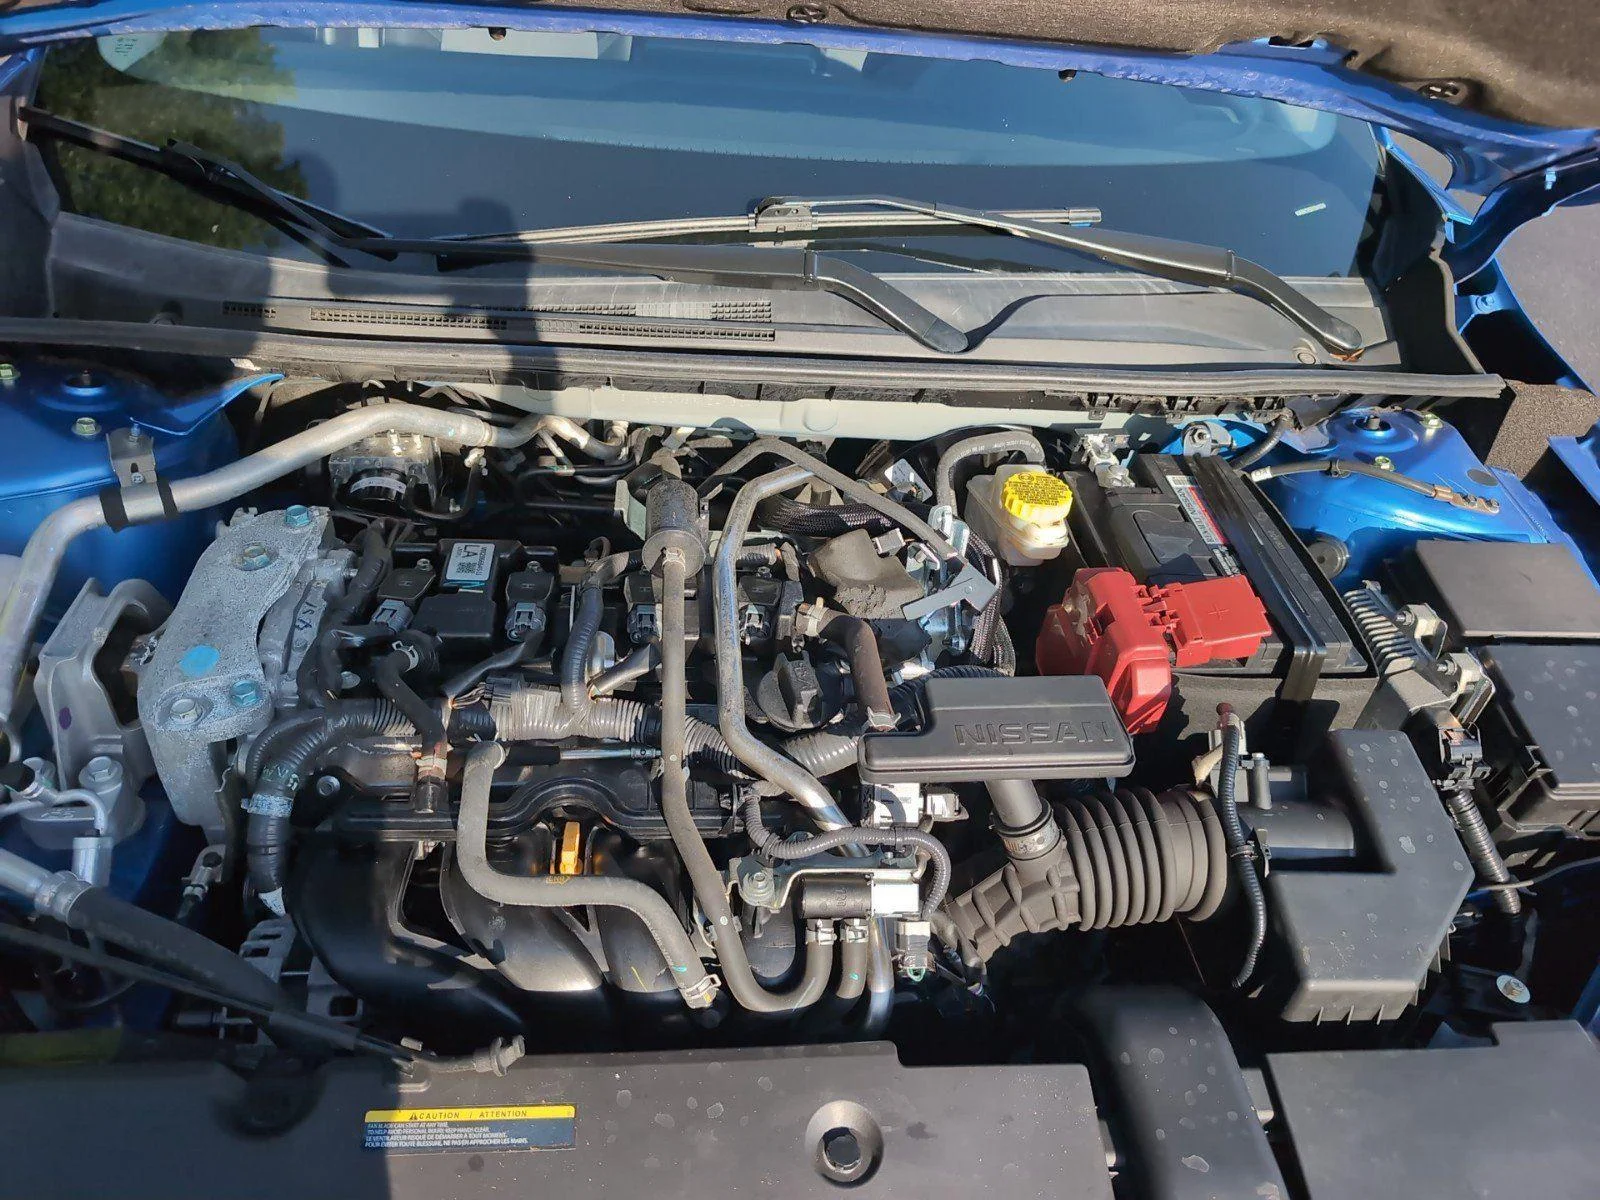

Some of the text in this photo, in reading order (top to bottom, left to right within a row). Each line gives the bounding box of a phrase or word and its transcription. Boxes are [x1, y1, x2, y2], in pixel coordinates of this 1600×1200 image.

[954, 721, 1114, 746] NISSAN
[419, 1112, 460, 1120] CAUTION
[479, 1110, 528, 1118] ATTENTION
